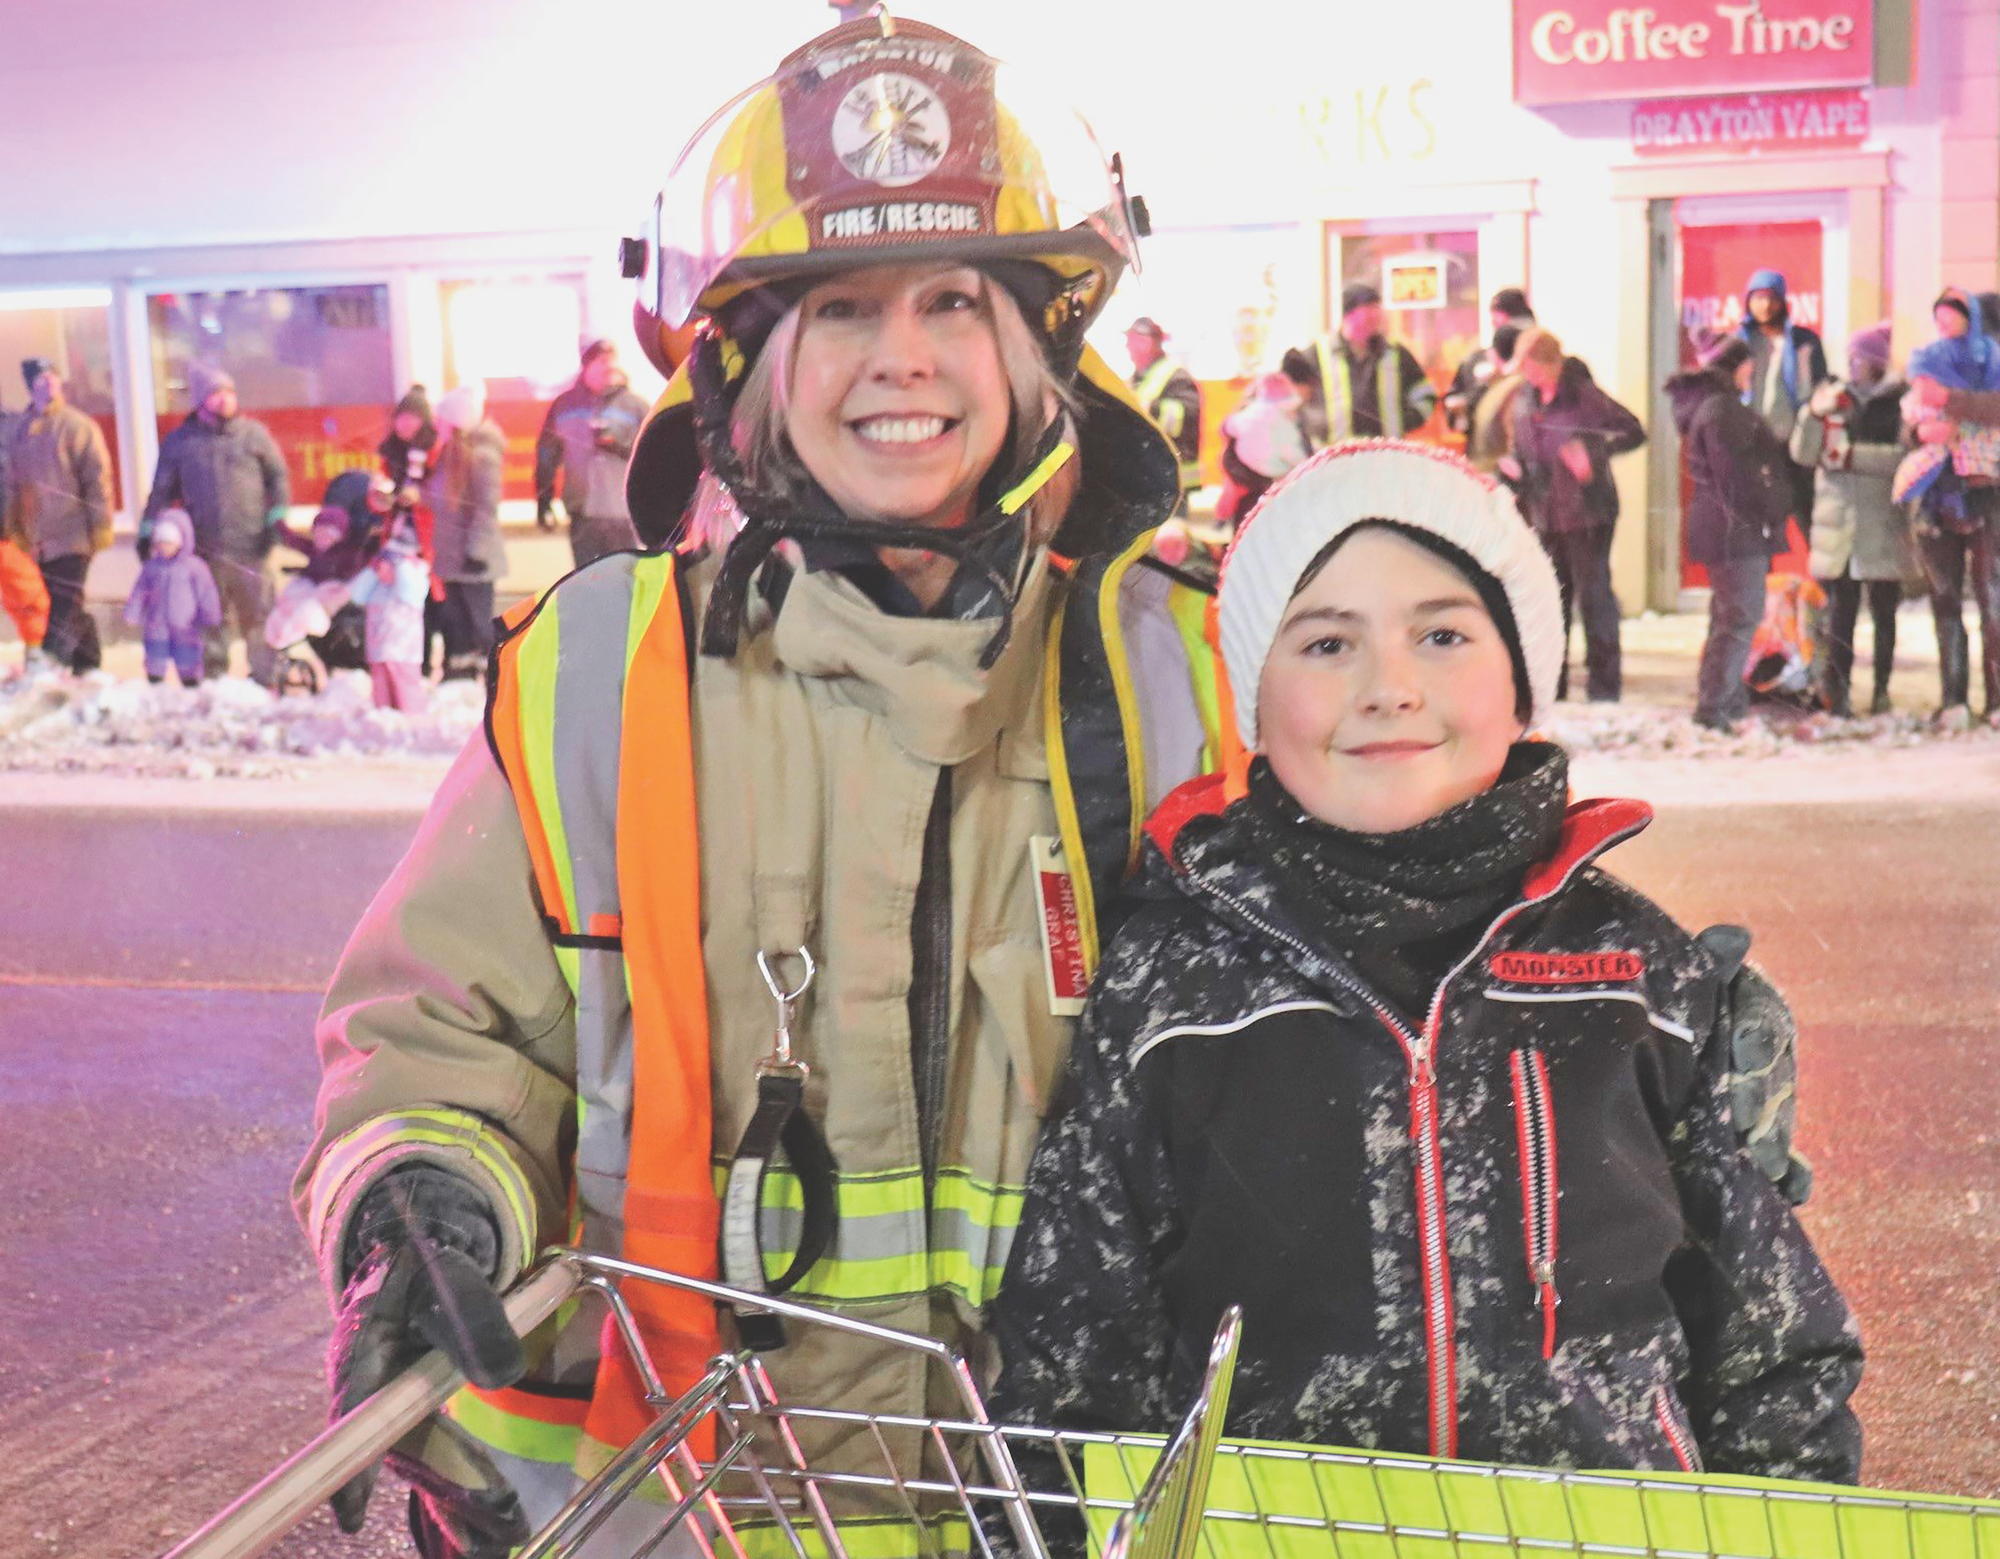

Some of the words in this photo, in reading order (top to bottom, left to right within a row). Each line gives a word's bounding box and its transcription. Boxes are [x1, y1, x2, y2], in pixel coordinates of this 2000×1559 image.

[1531, 9, 1710, 65] Coffee
[1716, 2, 1854, 56] Time
[1634, 104, 1774, 146] DRAYTON
[1780, 101, 1865, 139] VAPE
[822, 203, 981, 239] FIRE/RESCUE
[1683, 294, 1819, 325] DRAON
